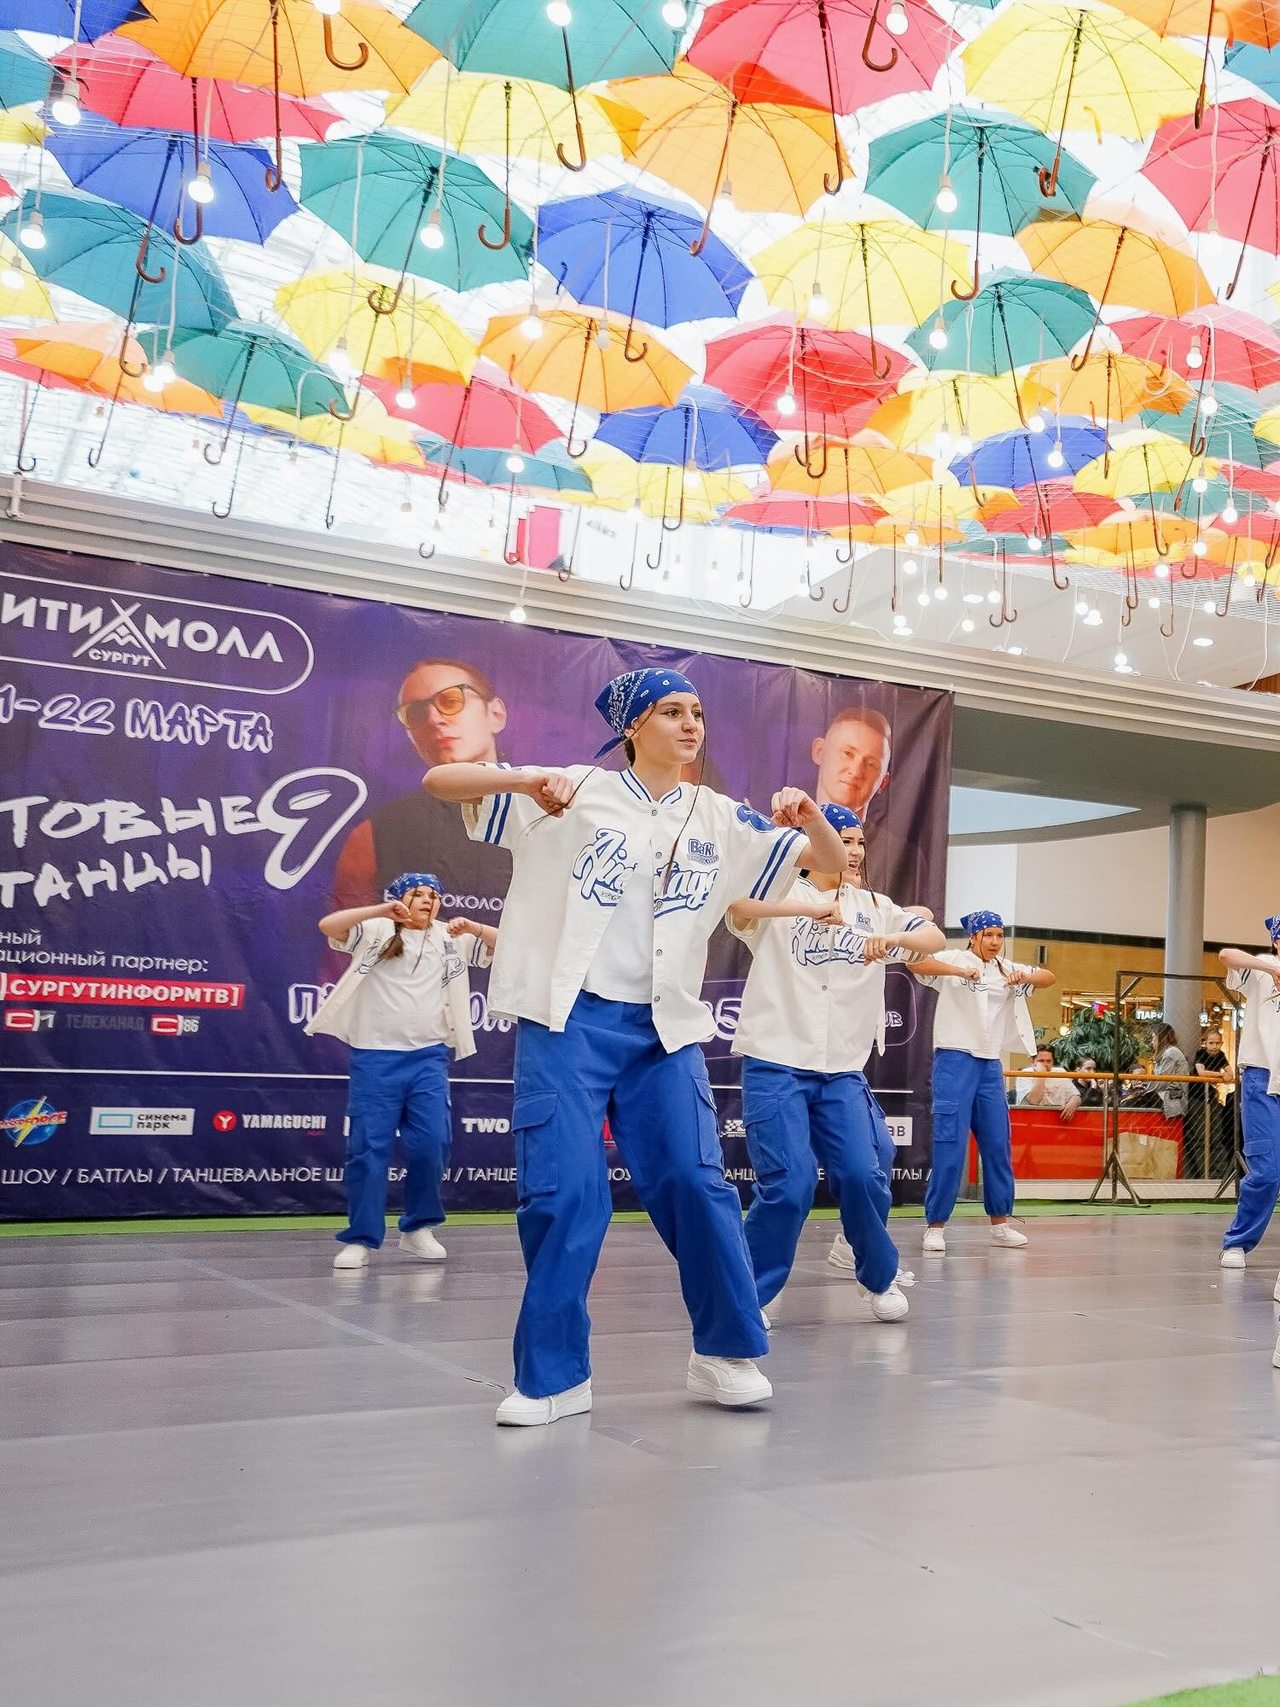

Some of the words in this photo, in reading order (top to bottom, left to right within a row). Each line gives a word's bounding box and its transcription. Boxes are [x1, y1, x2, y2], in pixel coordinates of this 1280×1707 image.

[88, 648, 152, 667] СУРГУТ
[125, 697, 274, 754] МАРТА
[0, 842, 212, 909] ТАНЦЫ
[440, 893, 506, 911] ОКОЛО
[112, 954, 209, 974] партнер:
[137, 1122, 171, 1132] парк
[242, 1114, 326, 1130] YAMAGUCHI
[2, 1168, 57, 1185] ШОУ
[77, 1167, 153, 1185] БАТТЛЫ
[172, 1167, 321, 1184] ТАНЦЕВАЛЬНОЕ
